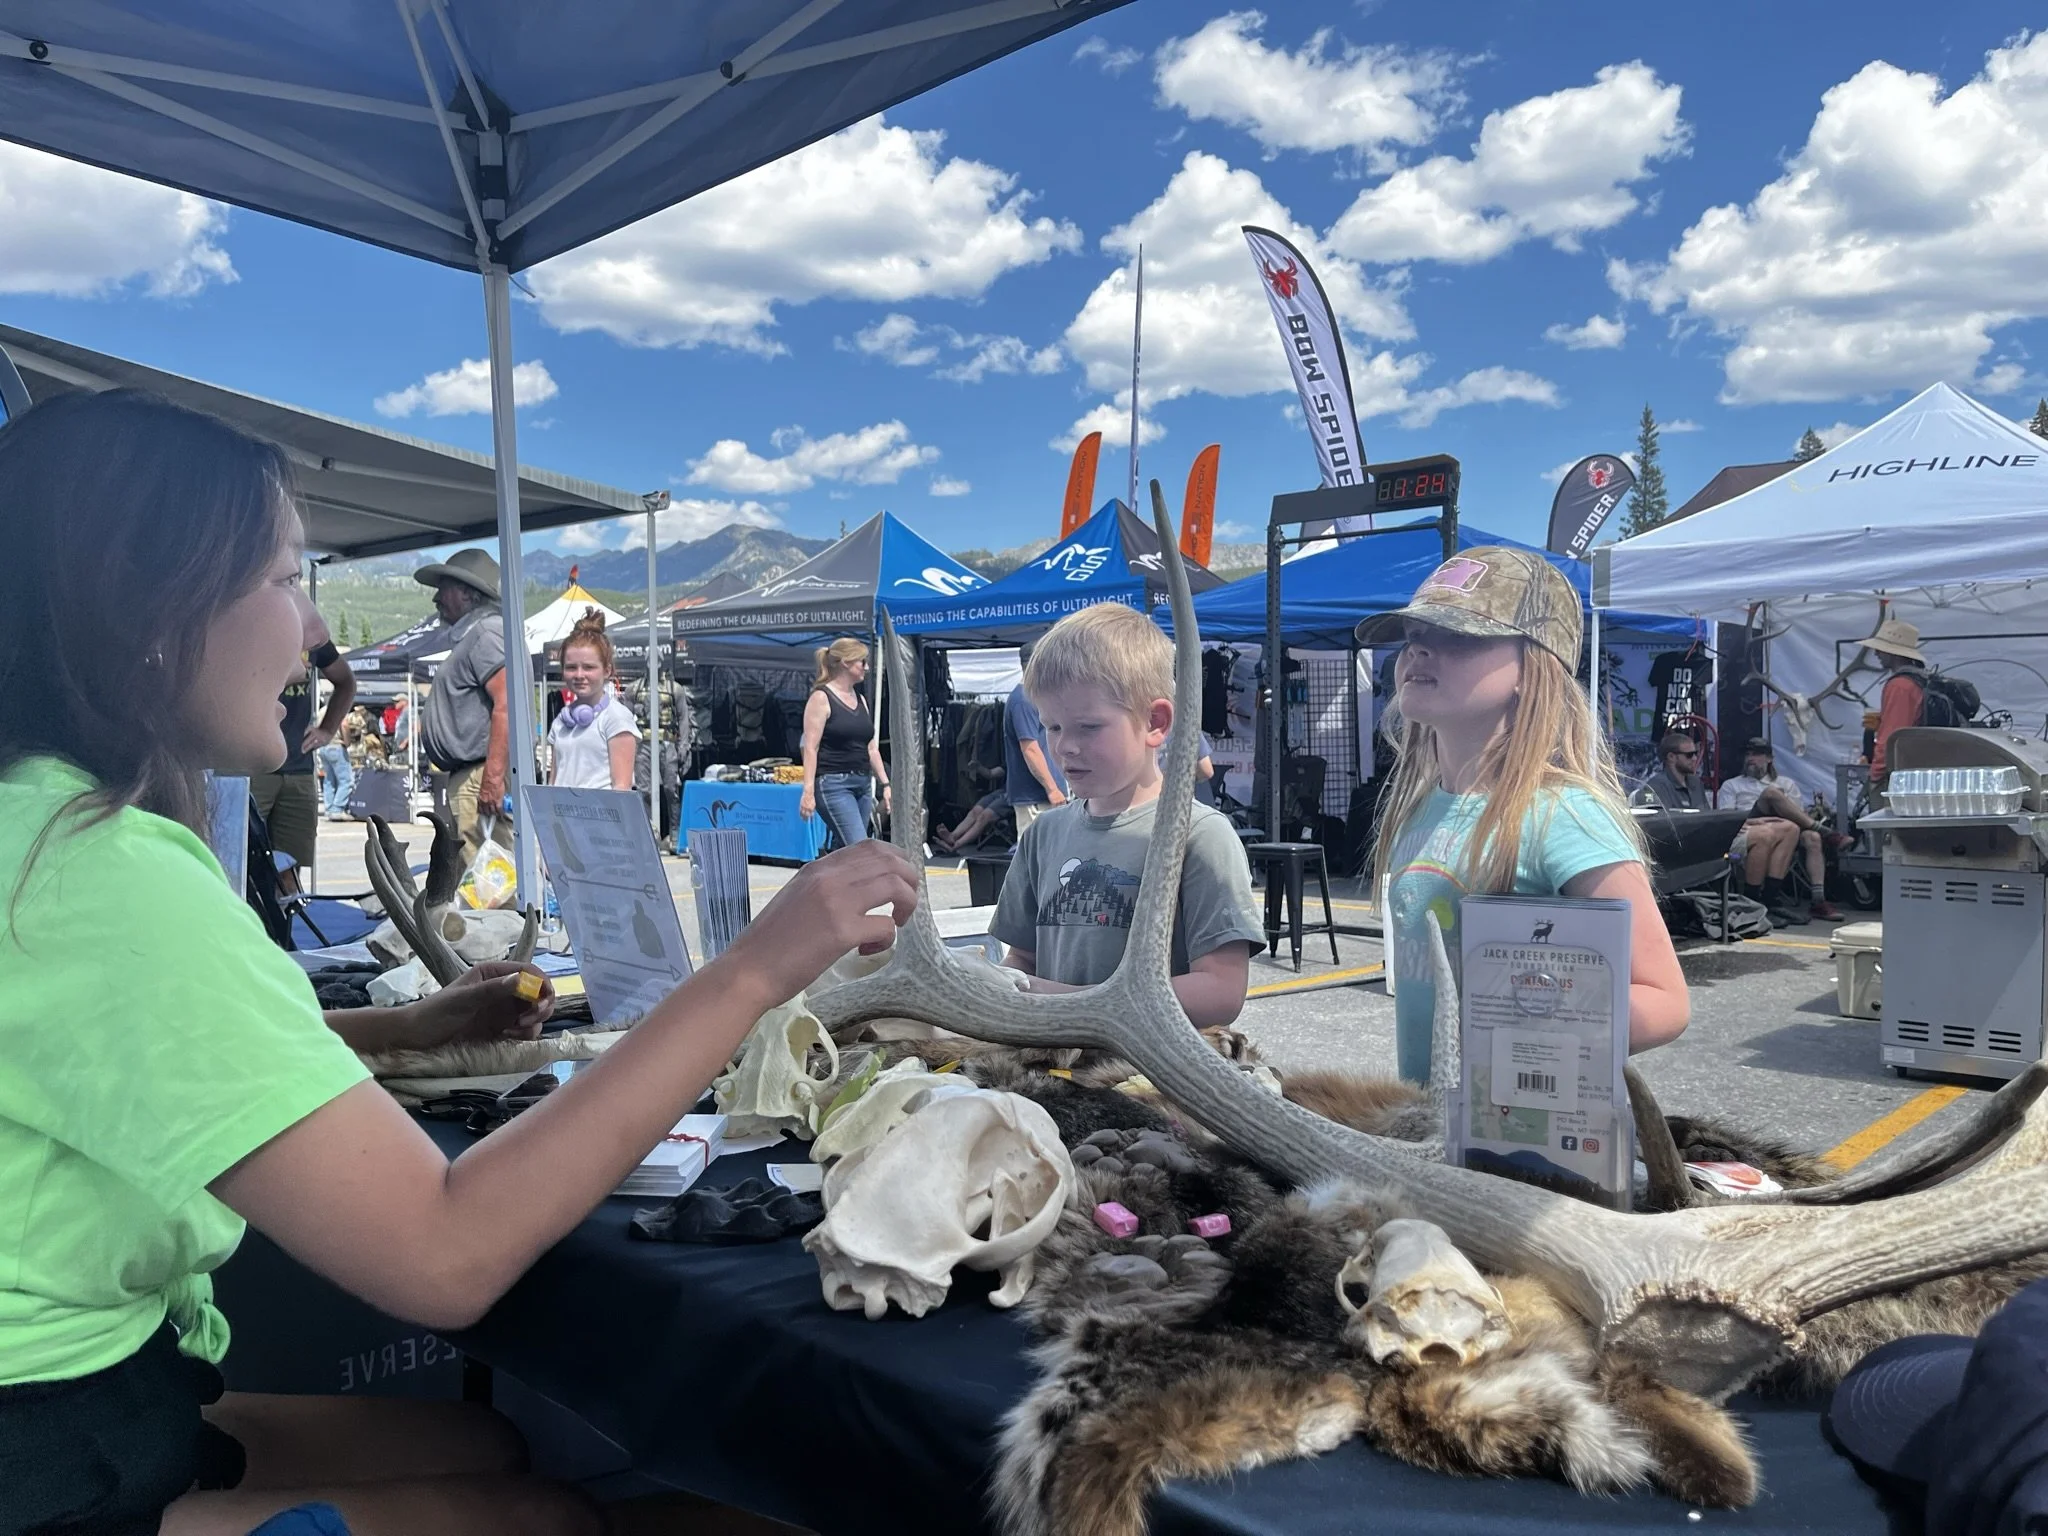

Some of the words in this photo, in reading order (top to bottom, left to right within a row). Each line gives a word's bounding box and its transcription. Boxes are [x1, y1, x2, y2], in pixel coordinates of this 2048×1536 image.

[1287, 313, 1325, 382] BOW
[1313, 393, 1355, 487] SPIDE
[1828, 455, 2039, 483] HIGHLINE
[1571, 493, 1615, 550] SPIDER
[678, 617, 722, 631] REDEFINING
[724, 615, 739, 626] THE
[740, 612, 794, 626] CAPABILITIES
[797, 612, 808, 622] OF
[811, 610, 867, 622] ULTRALIGHT.
[890, 611, 944, 626] EDEFINING
[947, 608, 966, 622] THE
[969, 604, 1039, 619] CAPABILITIES
[1042, 600, 1058, 614] OF
[1673, 668, 1692, 683] DO
[1665, 698, 1692, 713] CON
[1482, 949, 1509, 960] JACK
[1513, 950, 1545, 961] CREEK
[1551, 952, 1605, 966] PRESERVE
[1510, 961, 1575, 973] FOUNDATION
[1560, 978, 1573, 989] US
